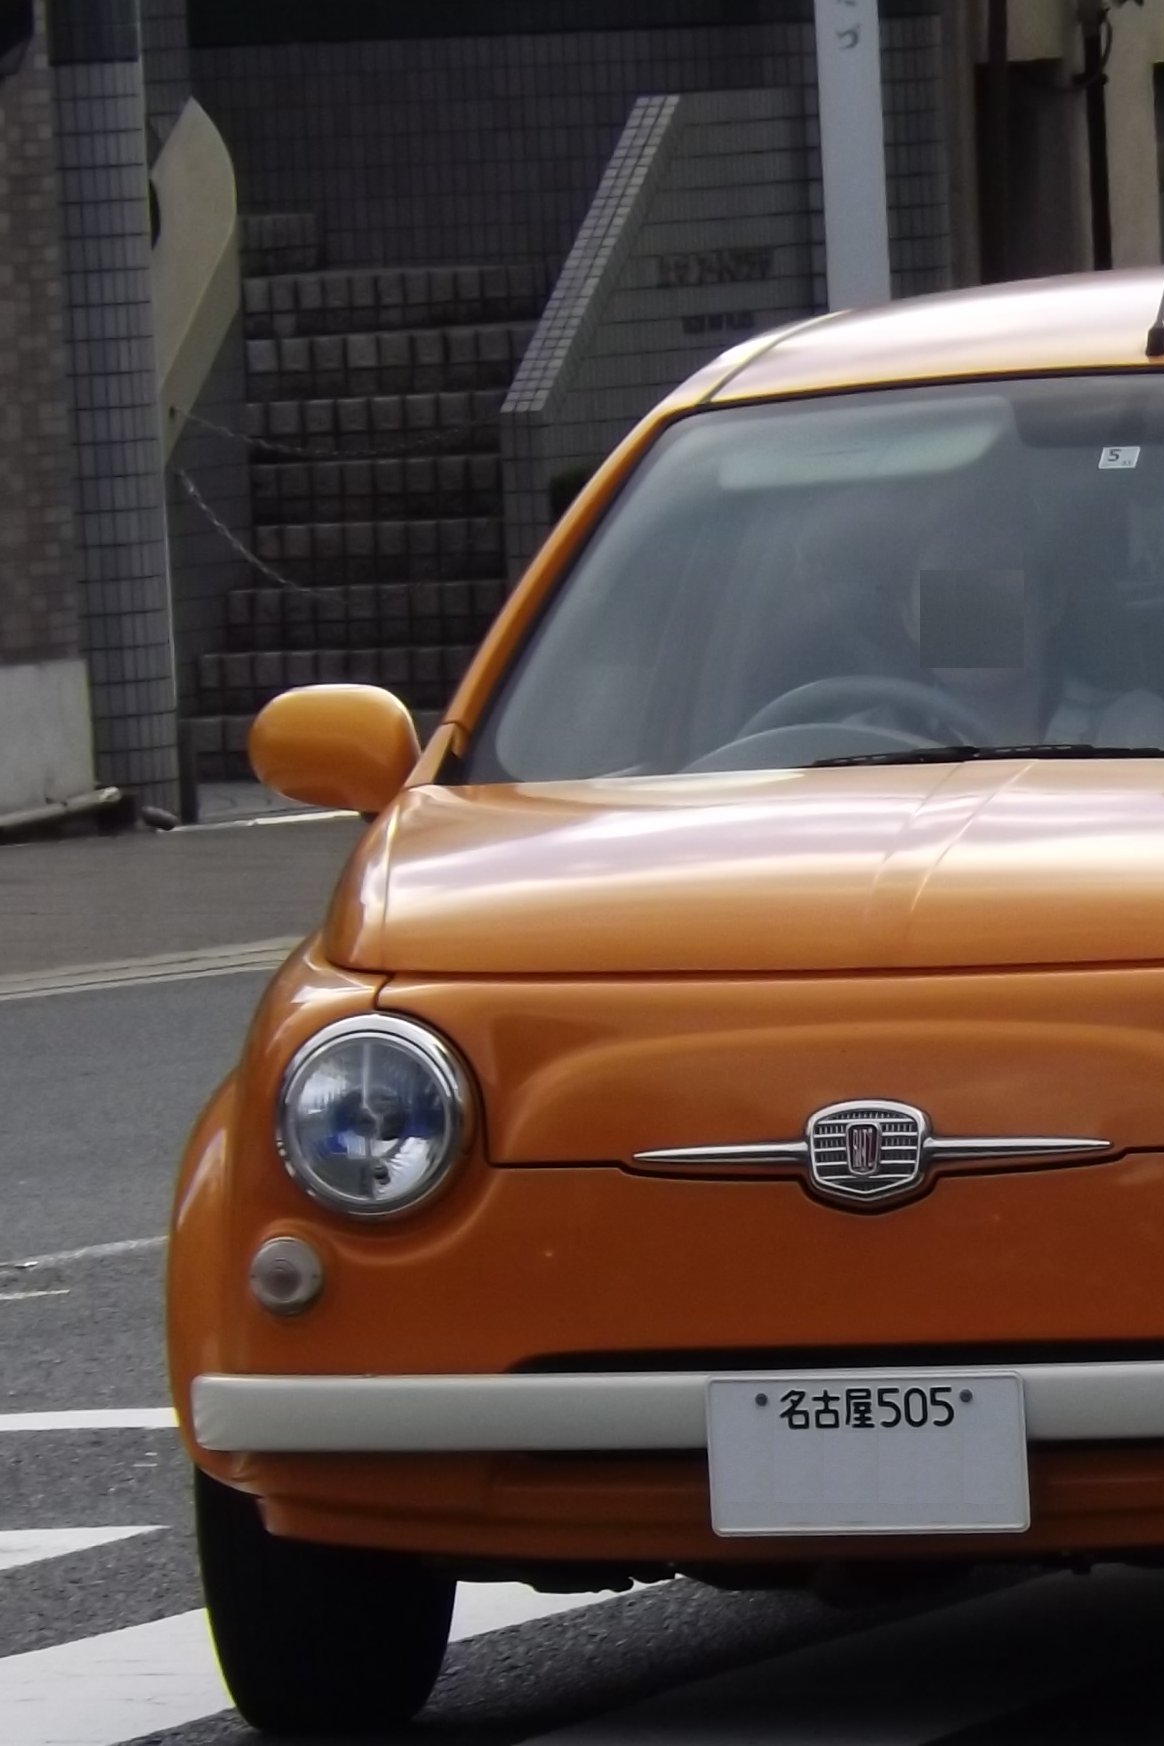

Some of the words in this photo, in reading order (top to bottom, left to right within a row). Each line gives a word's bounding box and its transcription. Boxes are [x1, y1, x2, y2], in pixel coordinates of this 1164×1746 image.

[1108, 448, 1121, 462] 5
[779, 1386, 955, 1430] 名古屋505
